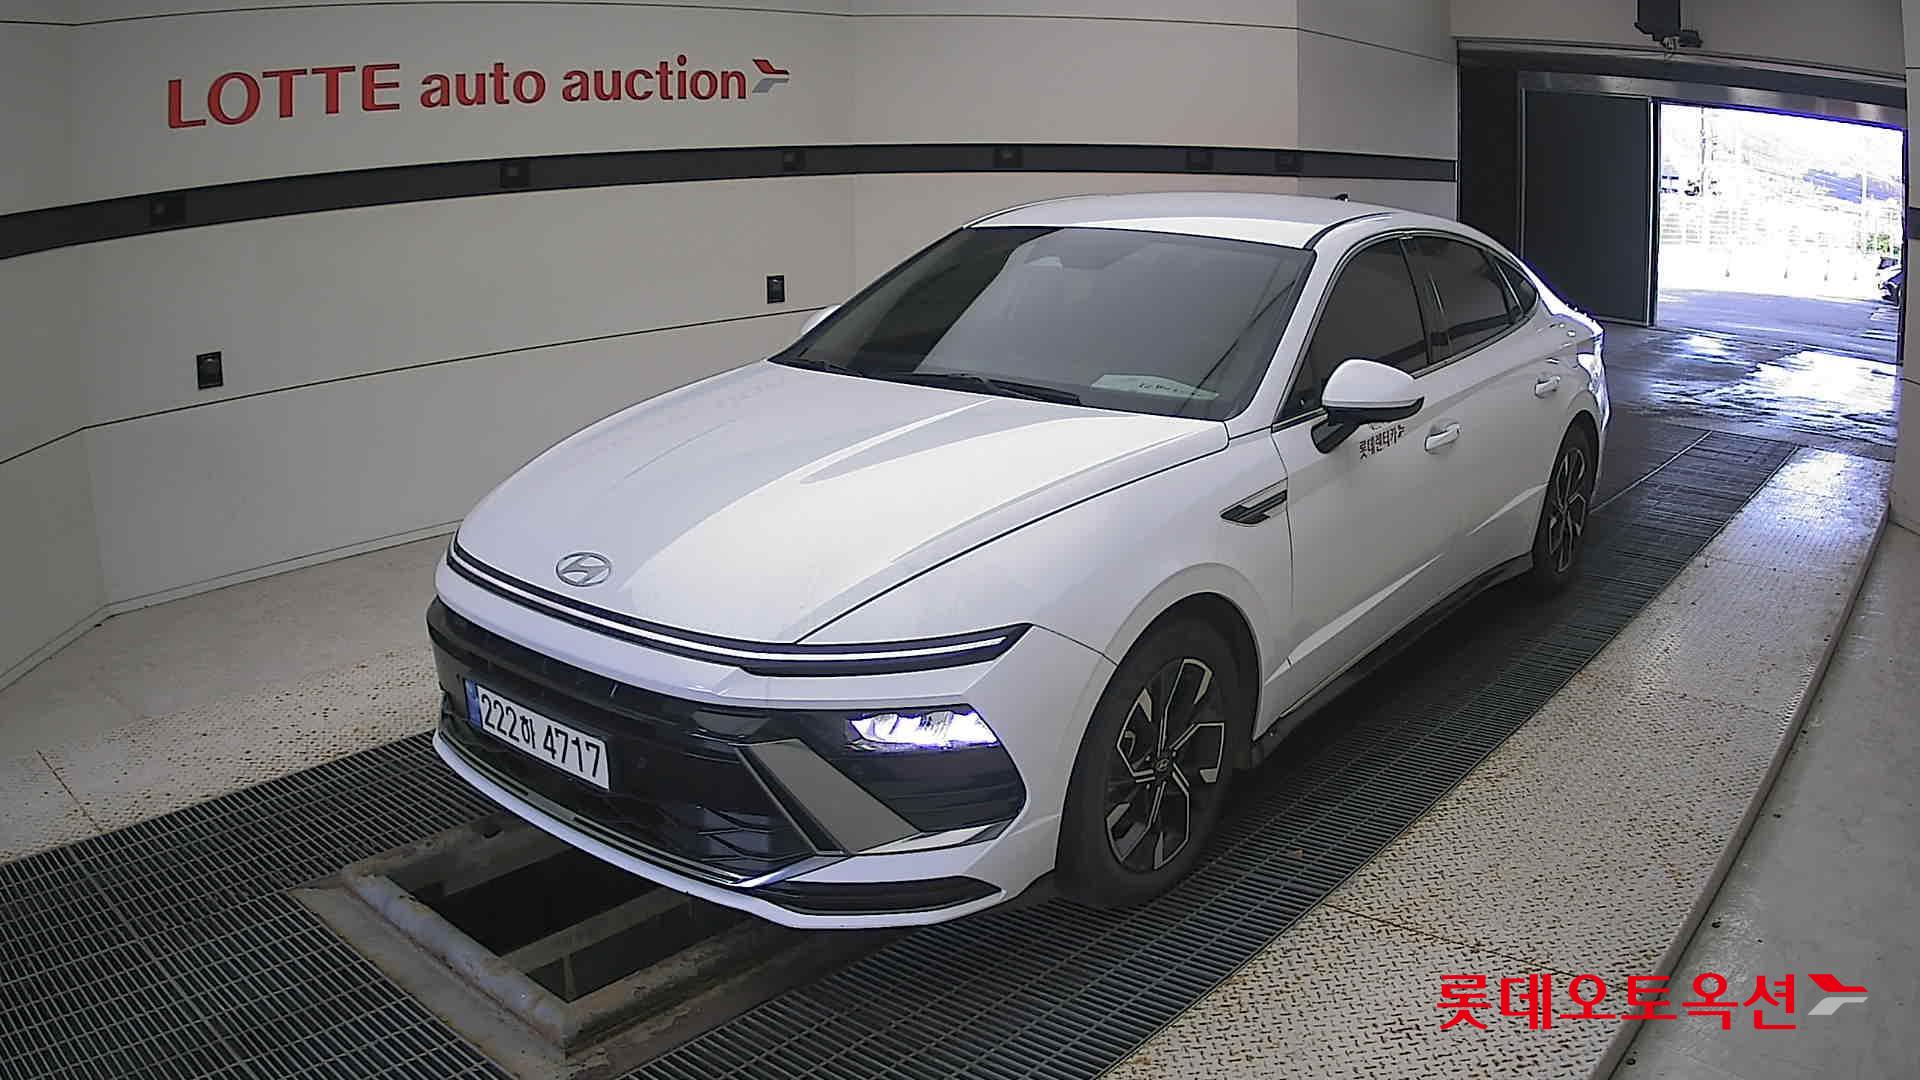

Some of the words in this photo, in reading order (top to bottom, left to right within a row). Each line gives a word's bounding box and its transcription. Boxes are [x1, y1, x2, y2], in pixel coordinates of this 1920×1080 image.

[168, 63, 400, 129] LOTTE
[420, 62, 546, 108] auto
[561, 54, 747, 102] auction
[481, 693, 536, 750] 222하
[543, 725, 601, 778] 4717
